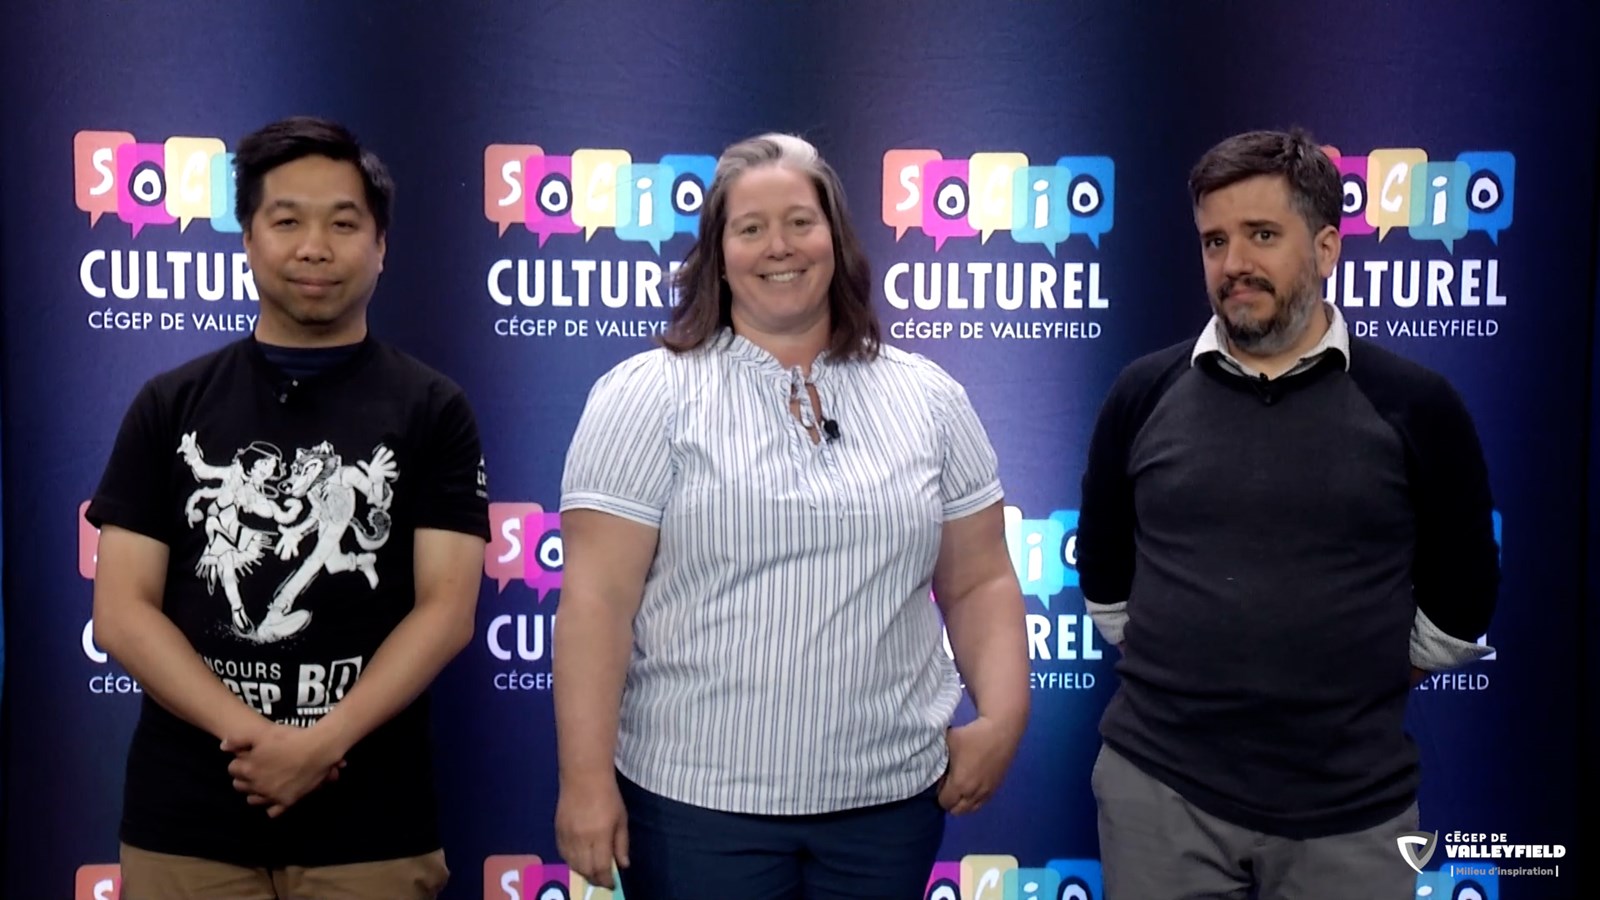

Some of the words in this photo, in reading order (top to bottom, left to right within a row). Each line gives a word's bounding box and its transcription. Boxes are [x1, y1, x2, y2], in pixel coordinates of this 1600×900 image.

[884, 262, 1109, 310] CULTUREL
[88, 306, 153, 329] CÉGEP
[160, 313, 185, 330] DE
[494, 315, 557, 336] CÉGEP
[565, 320, 588, 336] DE
[890, 317, 954, 339] CÉGEP
[960, 322, 983, 339] DE
[990, 322, 1102, 339] VALLEYFIELD
[1355, 320, 1379, 338] DE
[1386, 319, 1499, 338] VALLEYFIELD
